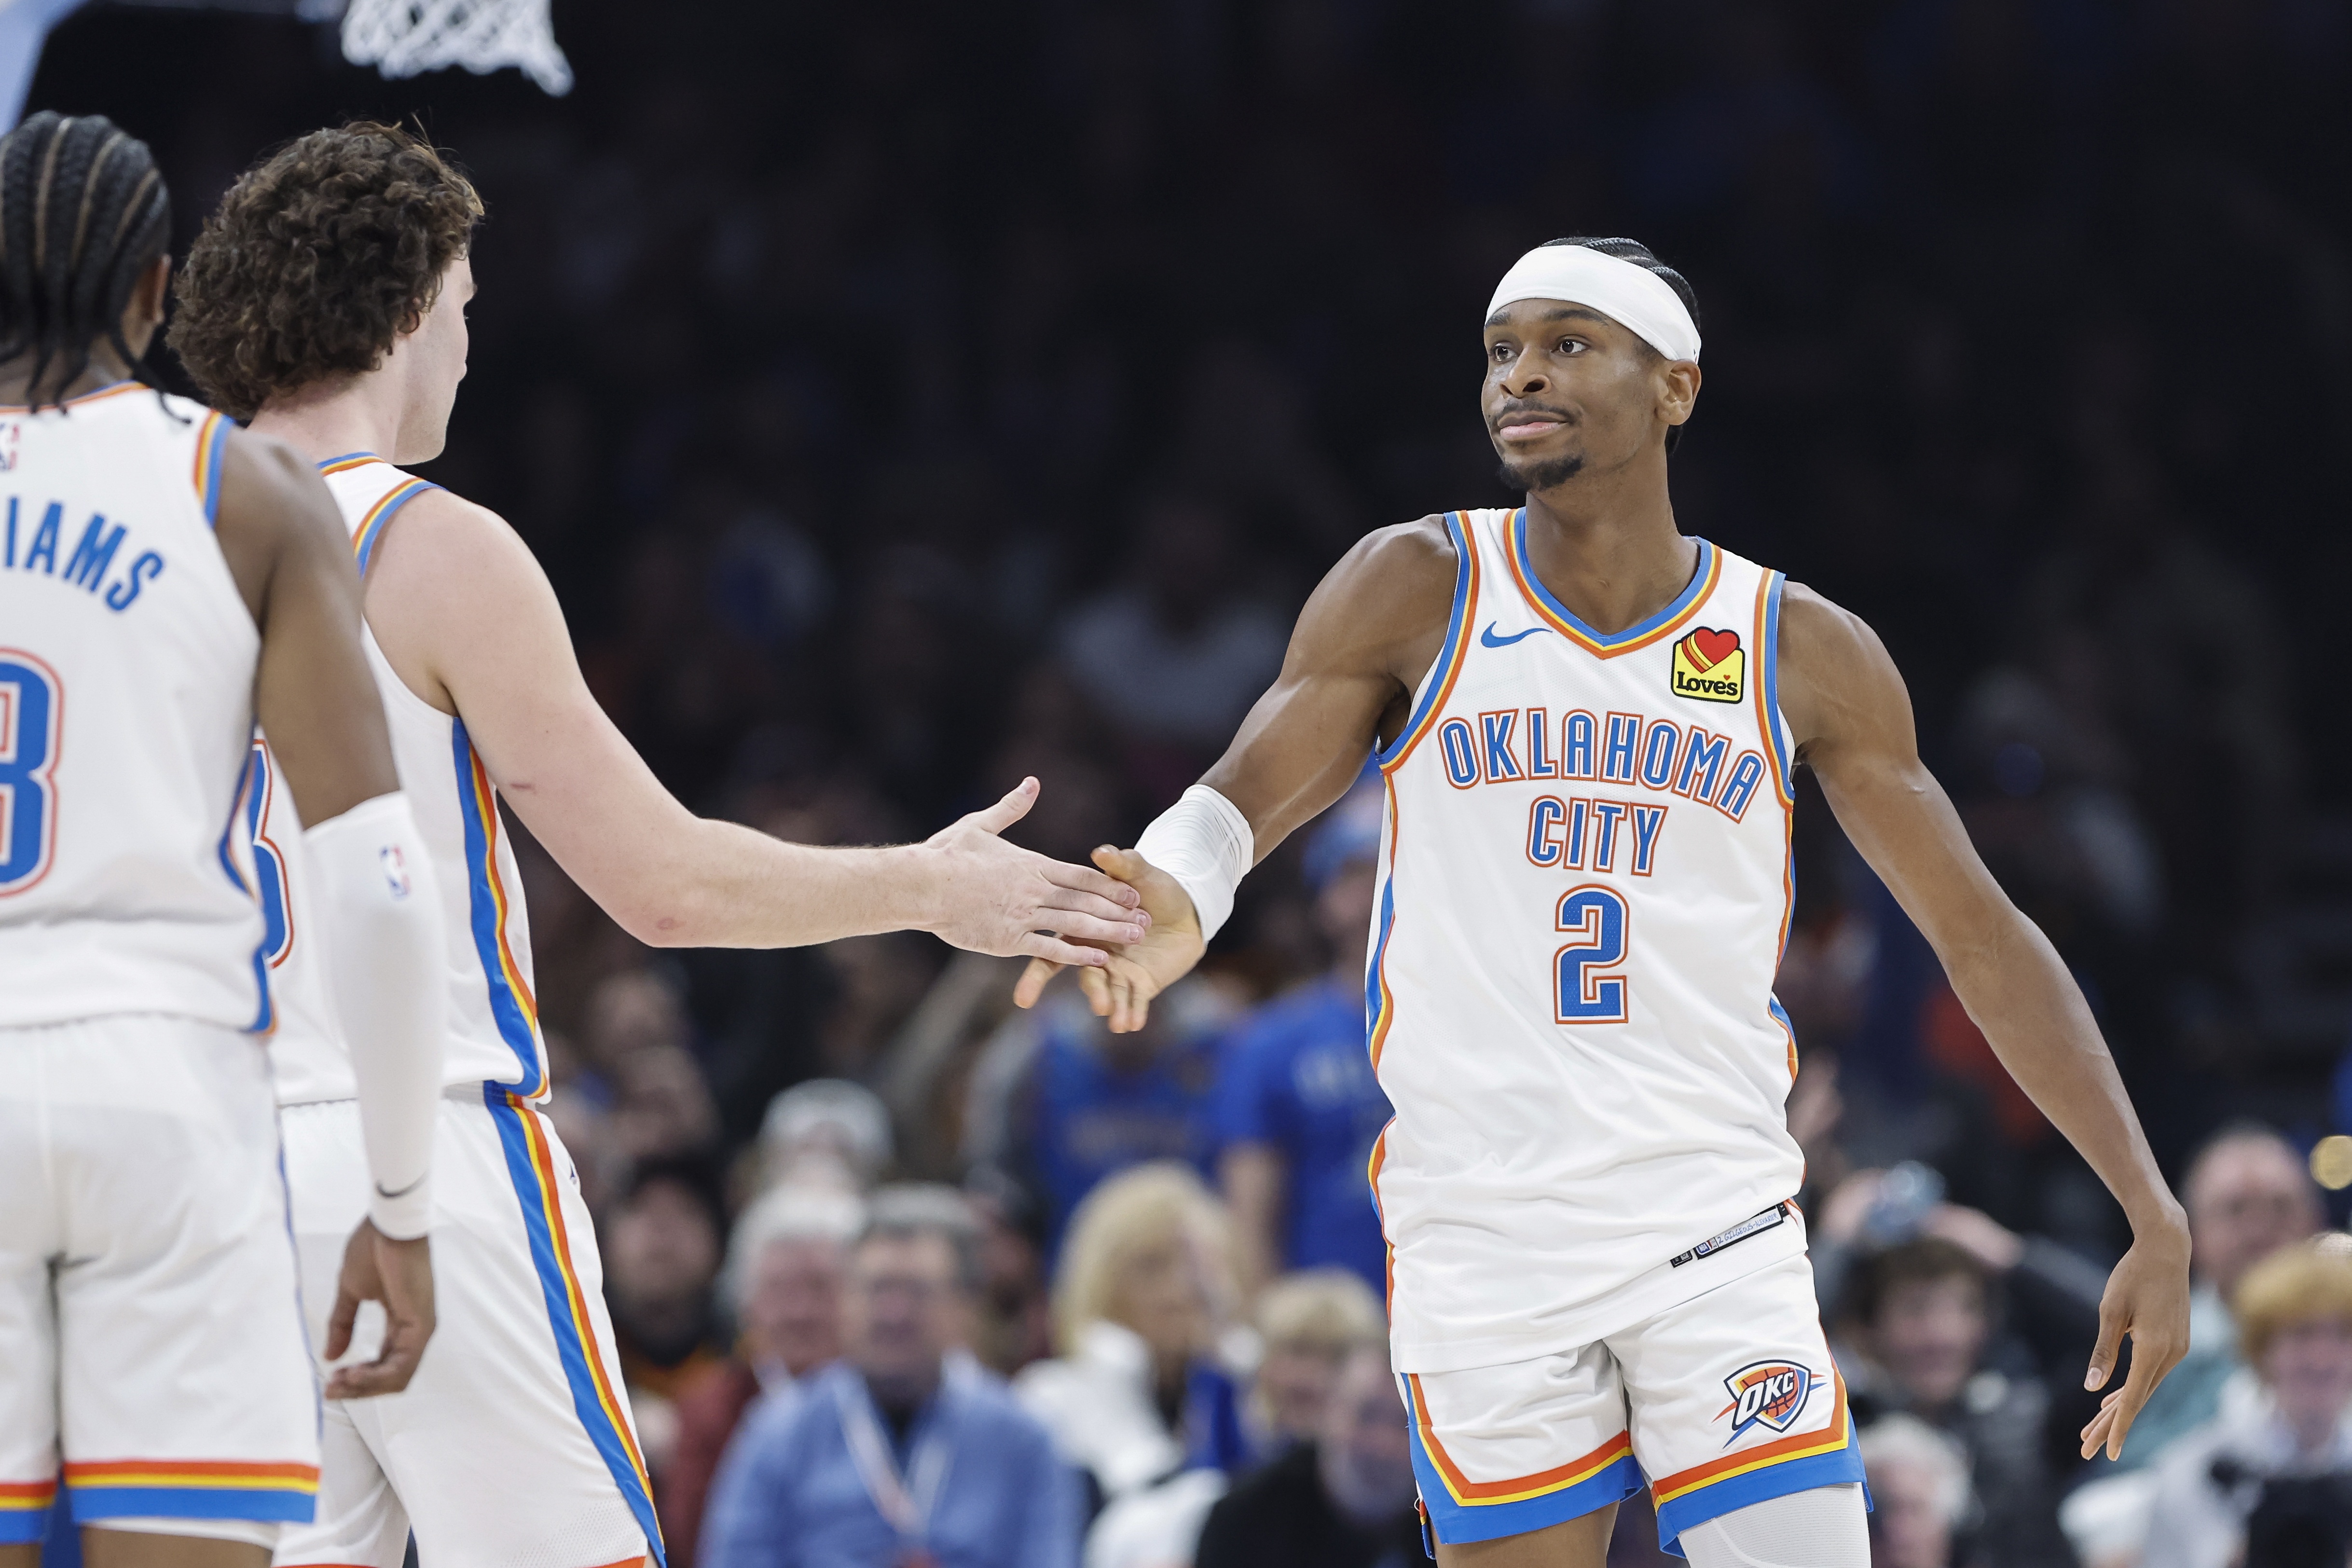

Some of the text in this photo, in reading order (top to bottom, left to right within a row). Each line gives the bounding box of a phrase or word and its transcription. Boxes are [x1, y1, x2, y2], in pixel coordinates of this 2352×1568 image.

[1438, 708, 1764, 824] OKLAHOMA
[1526, 796, 1668, 877] CITY
[1553, 883, 1629, 1024] 2
[1717, 1236, 1724, 1244] 2
[1734, 1371, 1794, 1428] OKC
